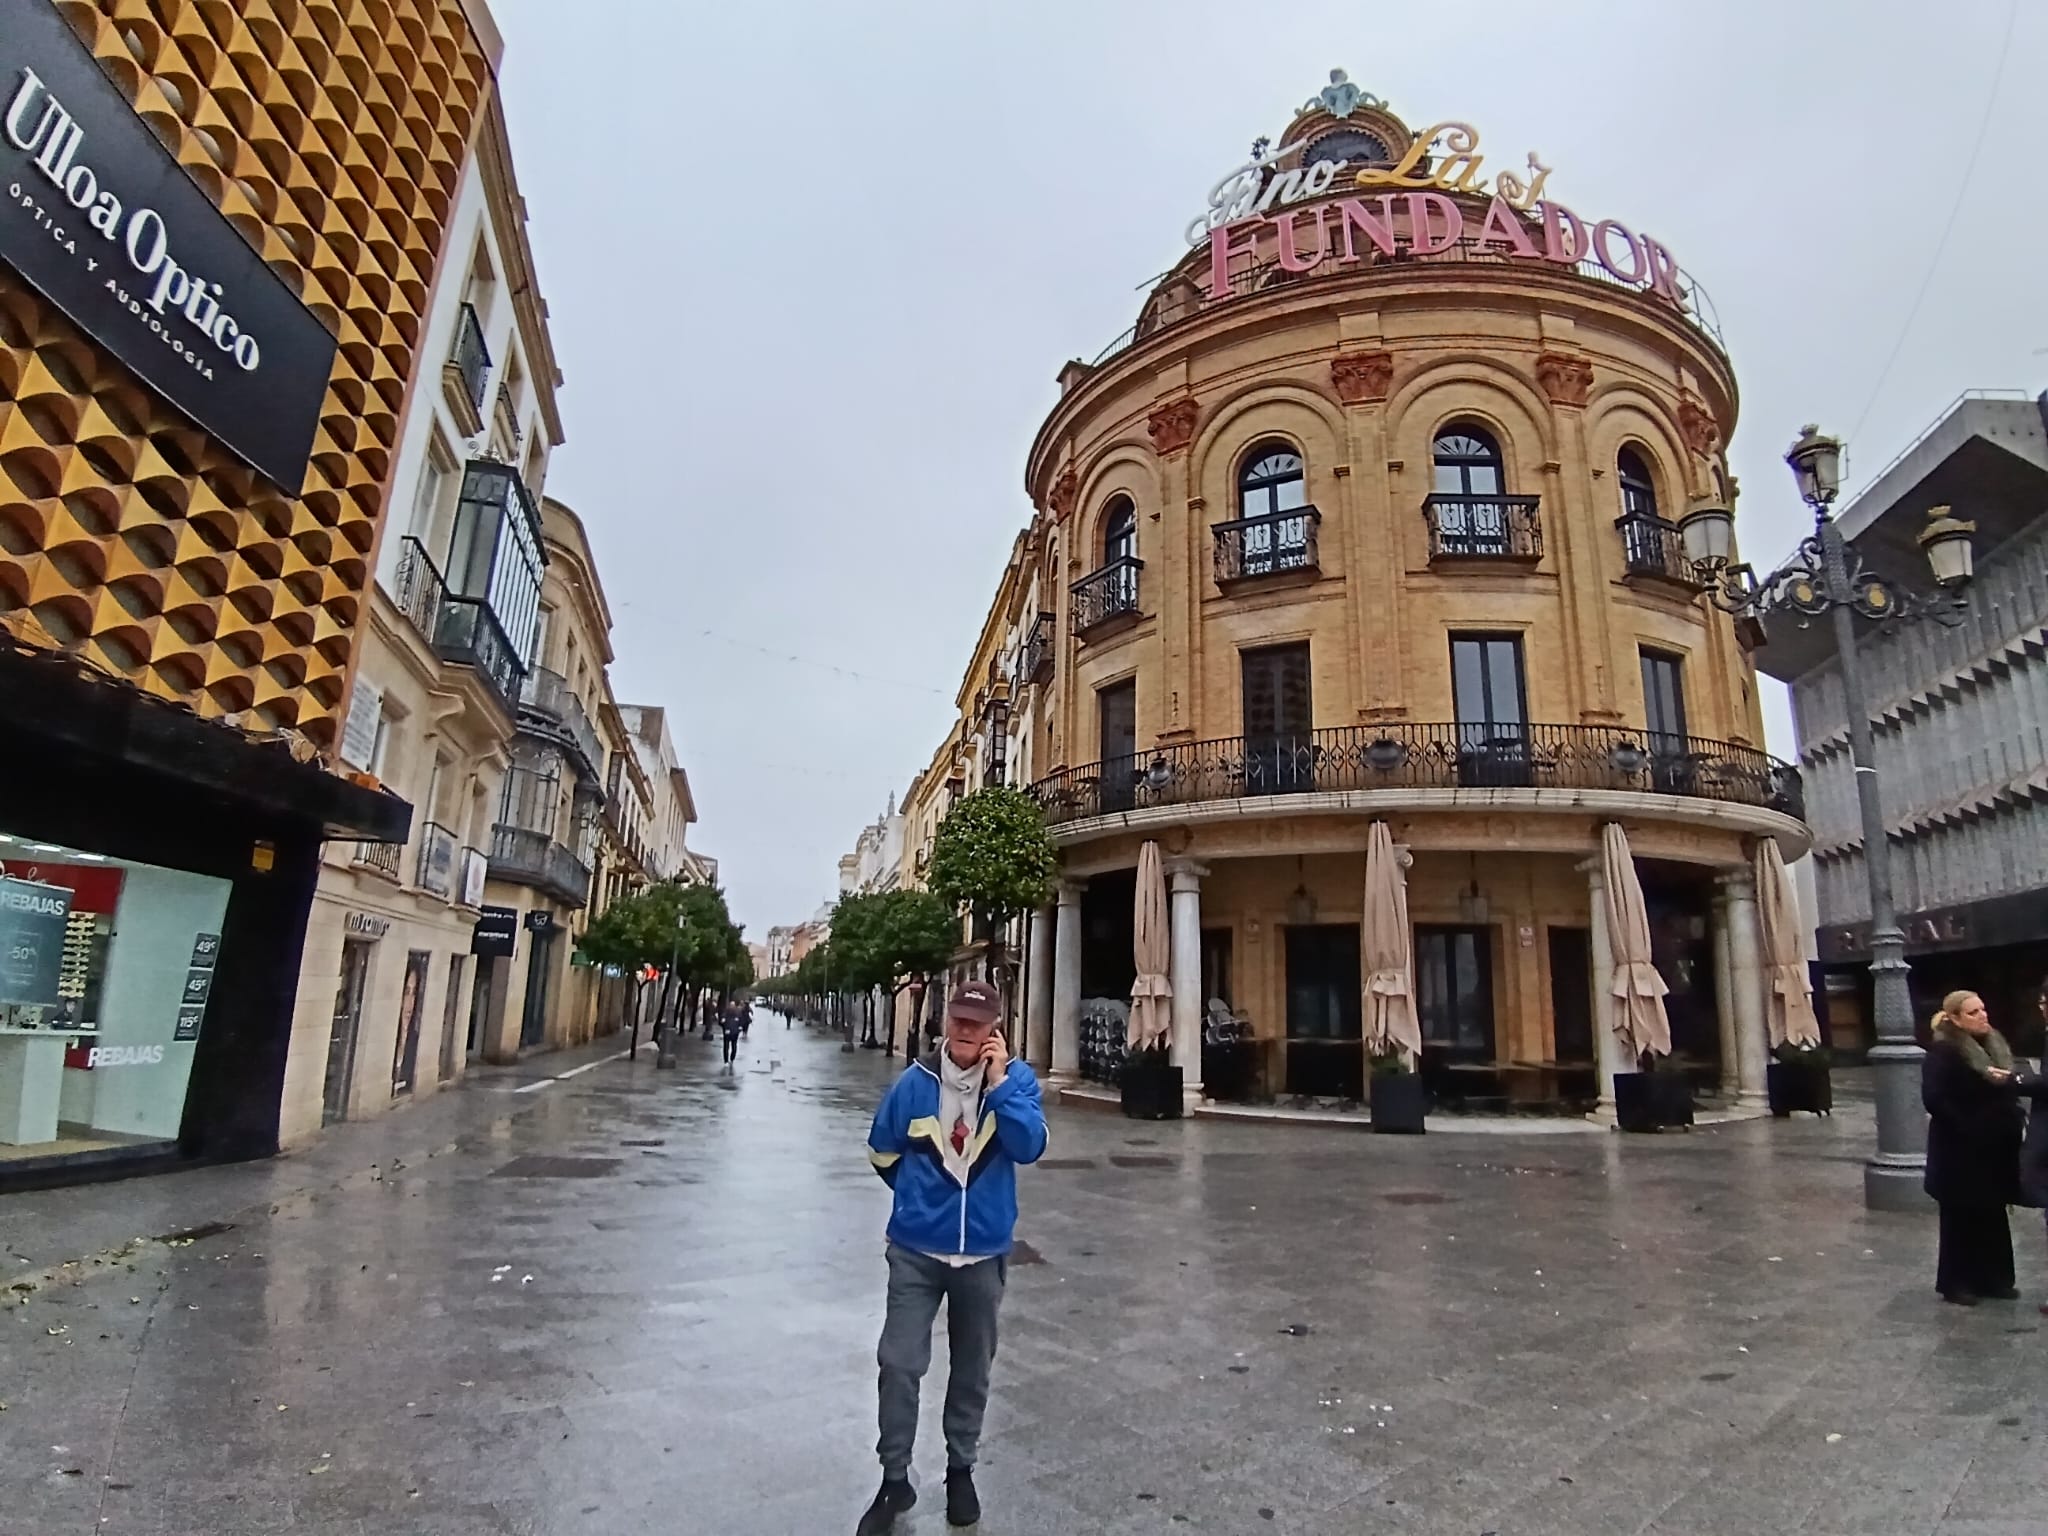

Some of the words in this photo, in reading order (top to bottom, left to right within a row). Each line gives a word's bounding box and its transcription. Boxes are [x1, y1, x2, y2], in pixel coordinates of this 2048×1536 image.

[5, 65, 122, 241] Ulloa
[125, 207, 260, 372] Optico
[1185, 138, 1348, 247] Fino
[1355, 120, 1489, 193] La
[86, 257, 98, 272] Y
[1206, 191, 1692, 315] FUNDADOR
[0, 890, 66, 916] REBAJAS
[87, 1044, 164, 1067] REBAJAS
